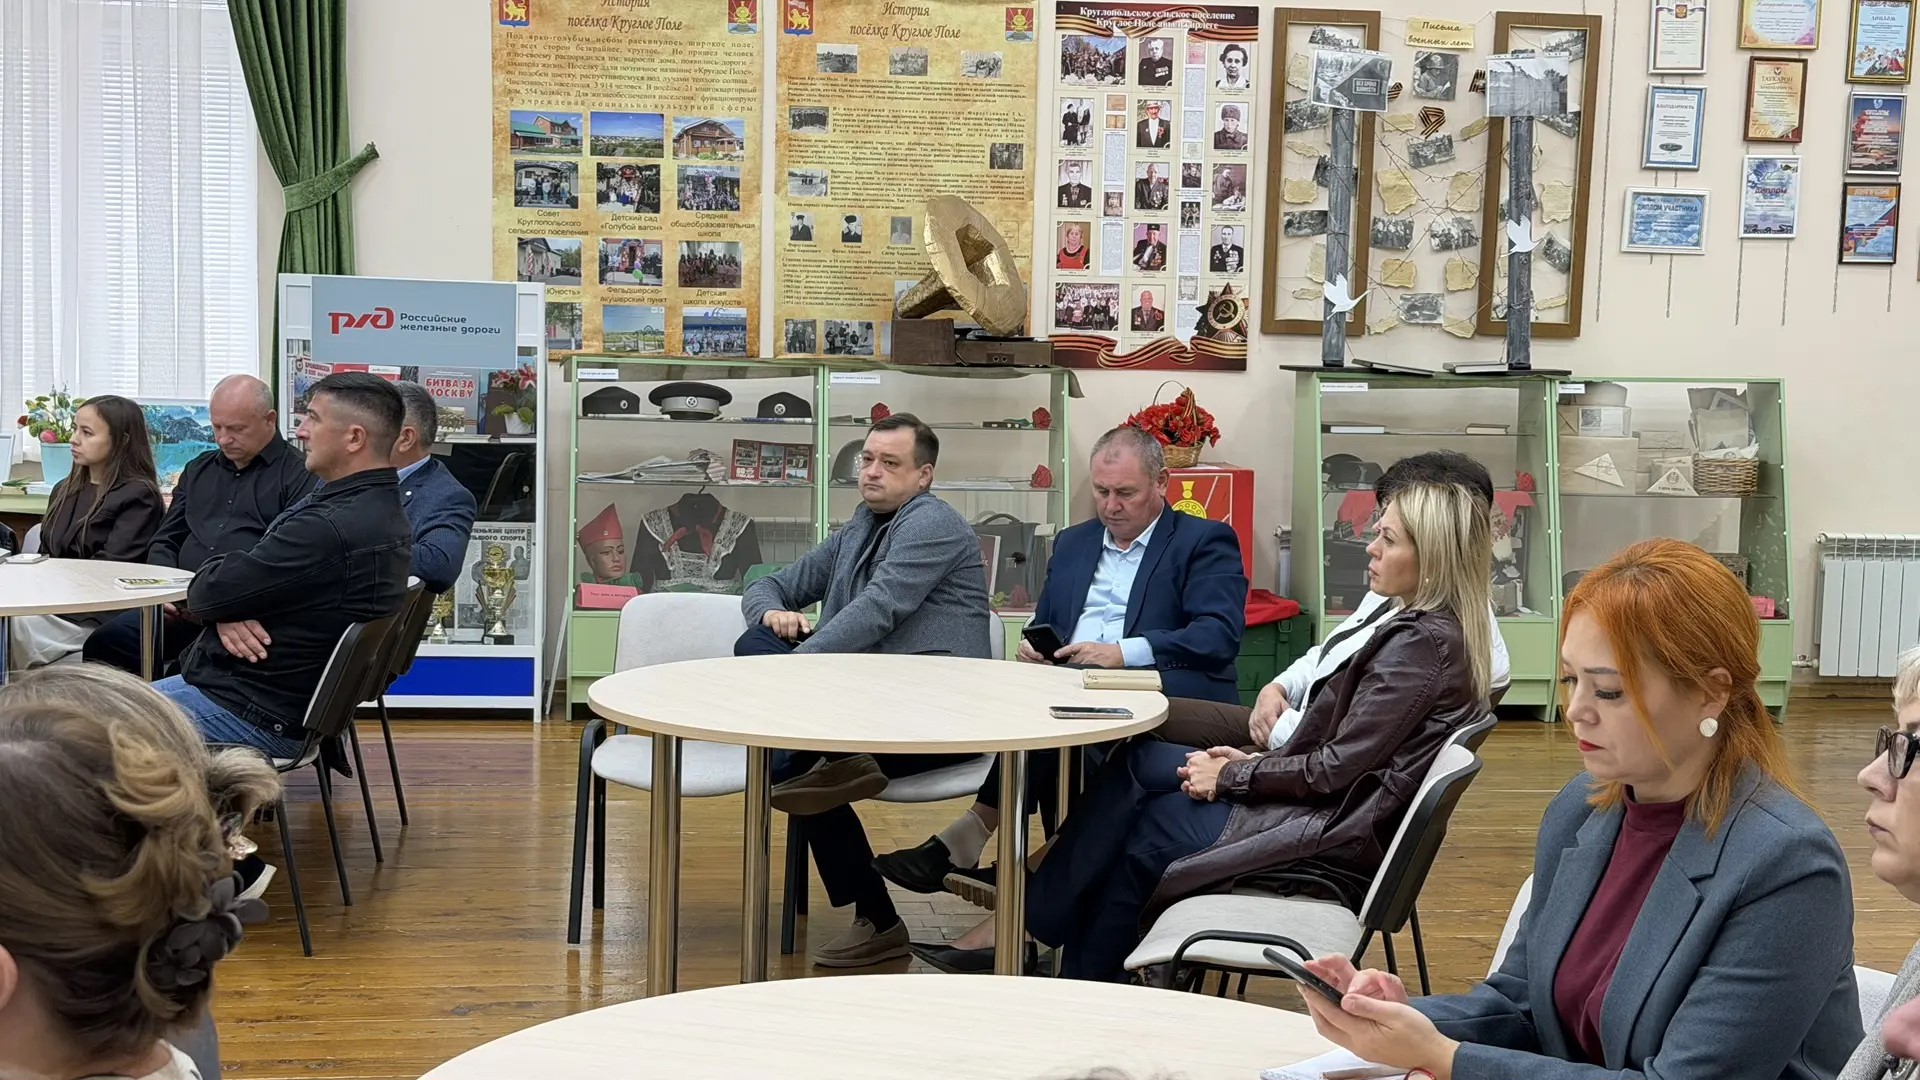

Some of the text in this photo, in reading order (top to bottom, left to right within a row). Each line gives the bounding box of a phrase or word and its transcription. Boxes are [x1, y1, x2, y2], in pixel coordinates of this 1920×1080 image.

[882, 1, 930, 20] История
[1079, 6, 1237, 21] Круглопольское сельское поселение
[567, 15, 683, 34] посёлка Круглое Поле
[1096, 17, 1135, 29] Круглое
[1421, 20, 1462, 33] Письма
[849, 20, 961, 42] посёлка Круглое Поле
[506, 31, 523, 40] Под
[595, 35, 623, 44] небом
[1407, 34, 1449, 46] военных
[536, 209, 560, 218] Совет
[1663, 203, 1698, 213] УЧАСТНИКА
[611, 212, 658, 223] Детский сад
[695, 211, 728, 222] Средняя
[517, 218, 582, 230] Круглопольского
[638, 223, 663, 232] вагон»
[670, 220, 756, 230] общеобразовательная
[508, 227, 589, 237] сельского поселения
[697, 230, 721, 238] школа
[546, 287, 581, 296] Юность»
[606, 286, 662, 298] Фельдшерско-
[695, 288, 727, 298] Детская
[600, 295, 667, 305] акушерский пункт
[683, 298, 742, 307] школа искусств
[400, 312, 468, 325] Российские
[400, 323, 501, 336] железные дороги
[425, 378, 475, 389] БИТВА ЗА
